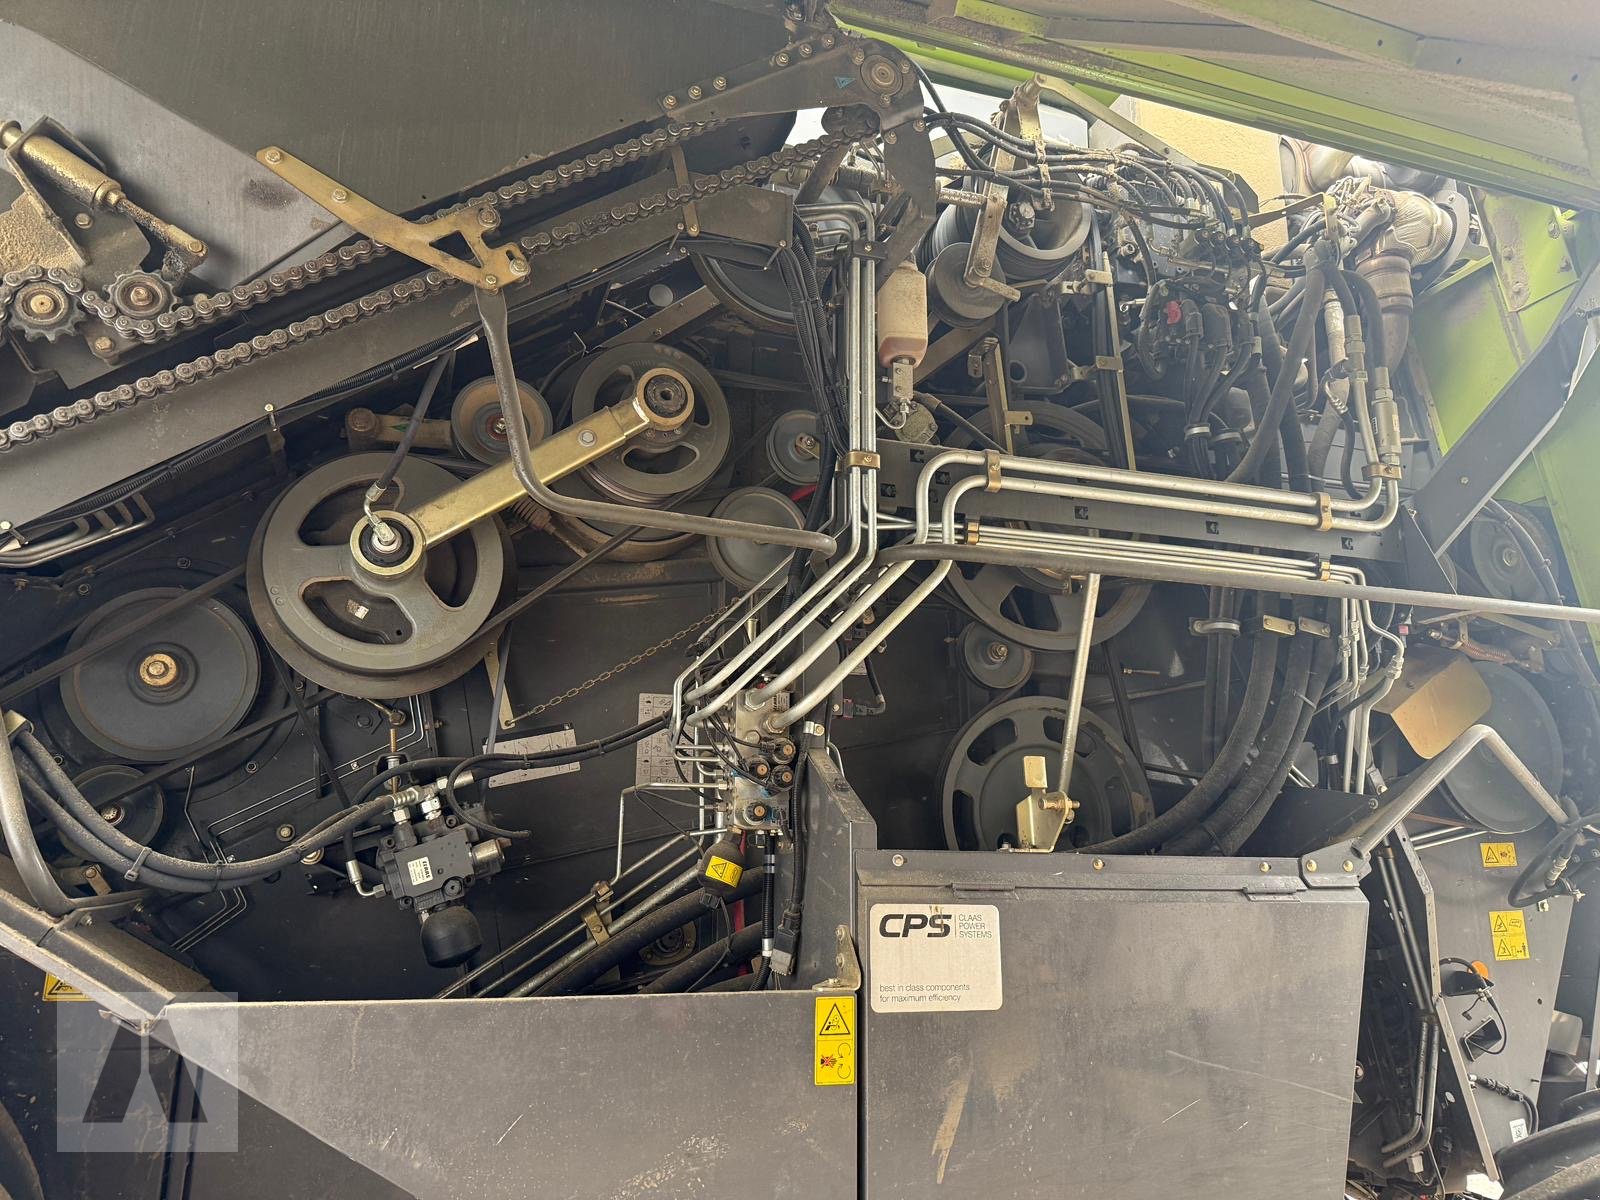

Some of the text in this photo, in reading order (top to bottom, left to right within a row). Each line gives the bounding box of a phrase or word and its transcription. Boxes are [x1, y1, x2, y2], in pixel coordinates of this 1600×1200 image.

[958, 914, 982, 922] CLAAS
[879, 914, 952, 938] CPS
[959, 922, 986, 930] POWER
[959, 930, 993, 939] SYSTEMS
[879, 983, 970, 993] best in class components
[879, 993, 961, 1004] for maximum efficiency
